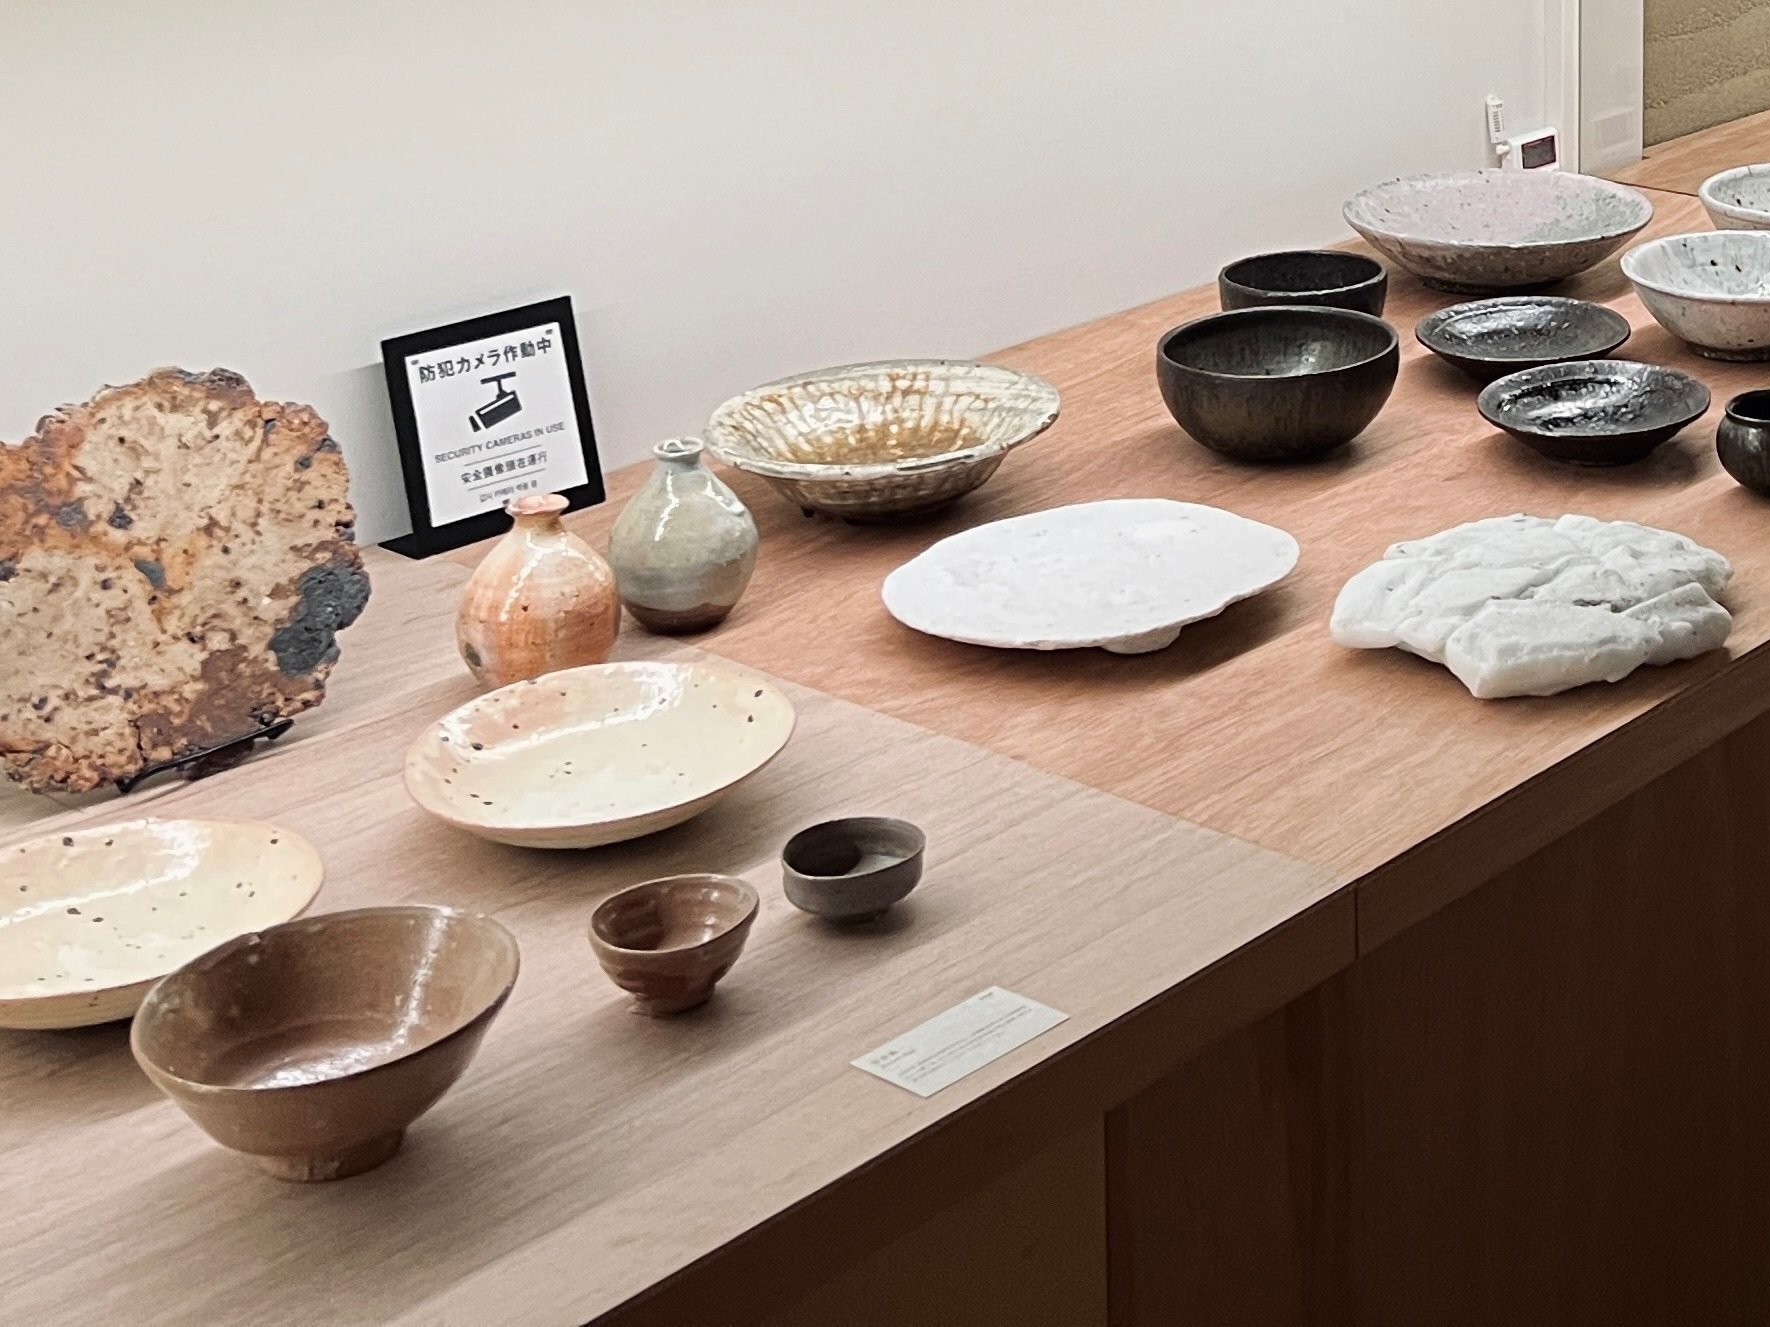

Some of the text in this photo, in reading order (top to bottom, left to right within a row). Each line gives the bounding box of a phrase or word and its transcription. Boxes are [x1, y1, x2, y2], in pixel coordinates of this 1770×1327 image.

[418, 337, 553, 384] 防犯カメラ作動中
[434, 444, 483, 464] SECURITY
[485, 430, 533, 450] CAMERAS
[545, 421, 566, 435] USE
